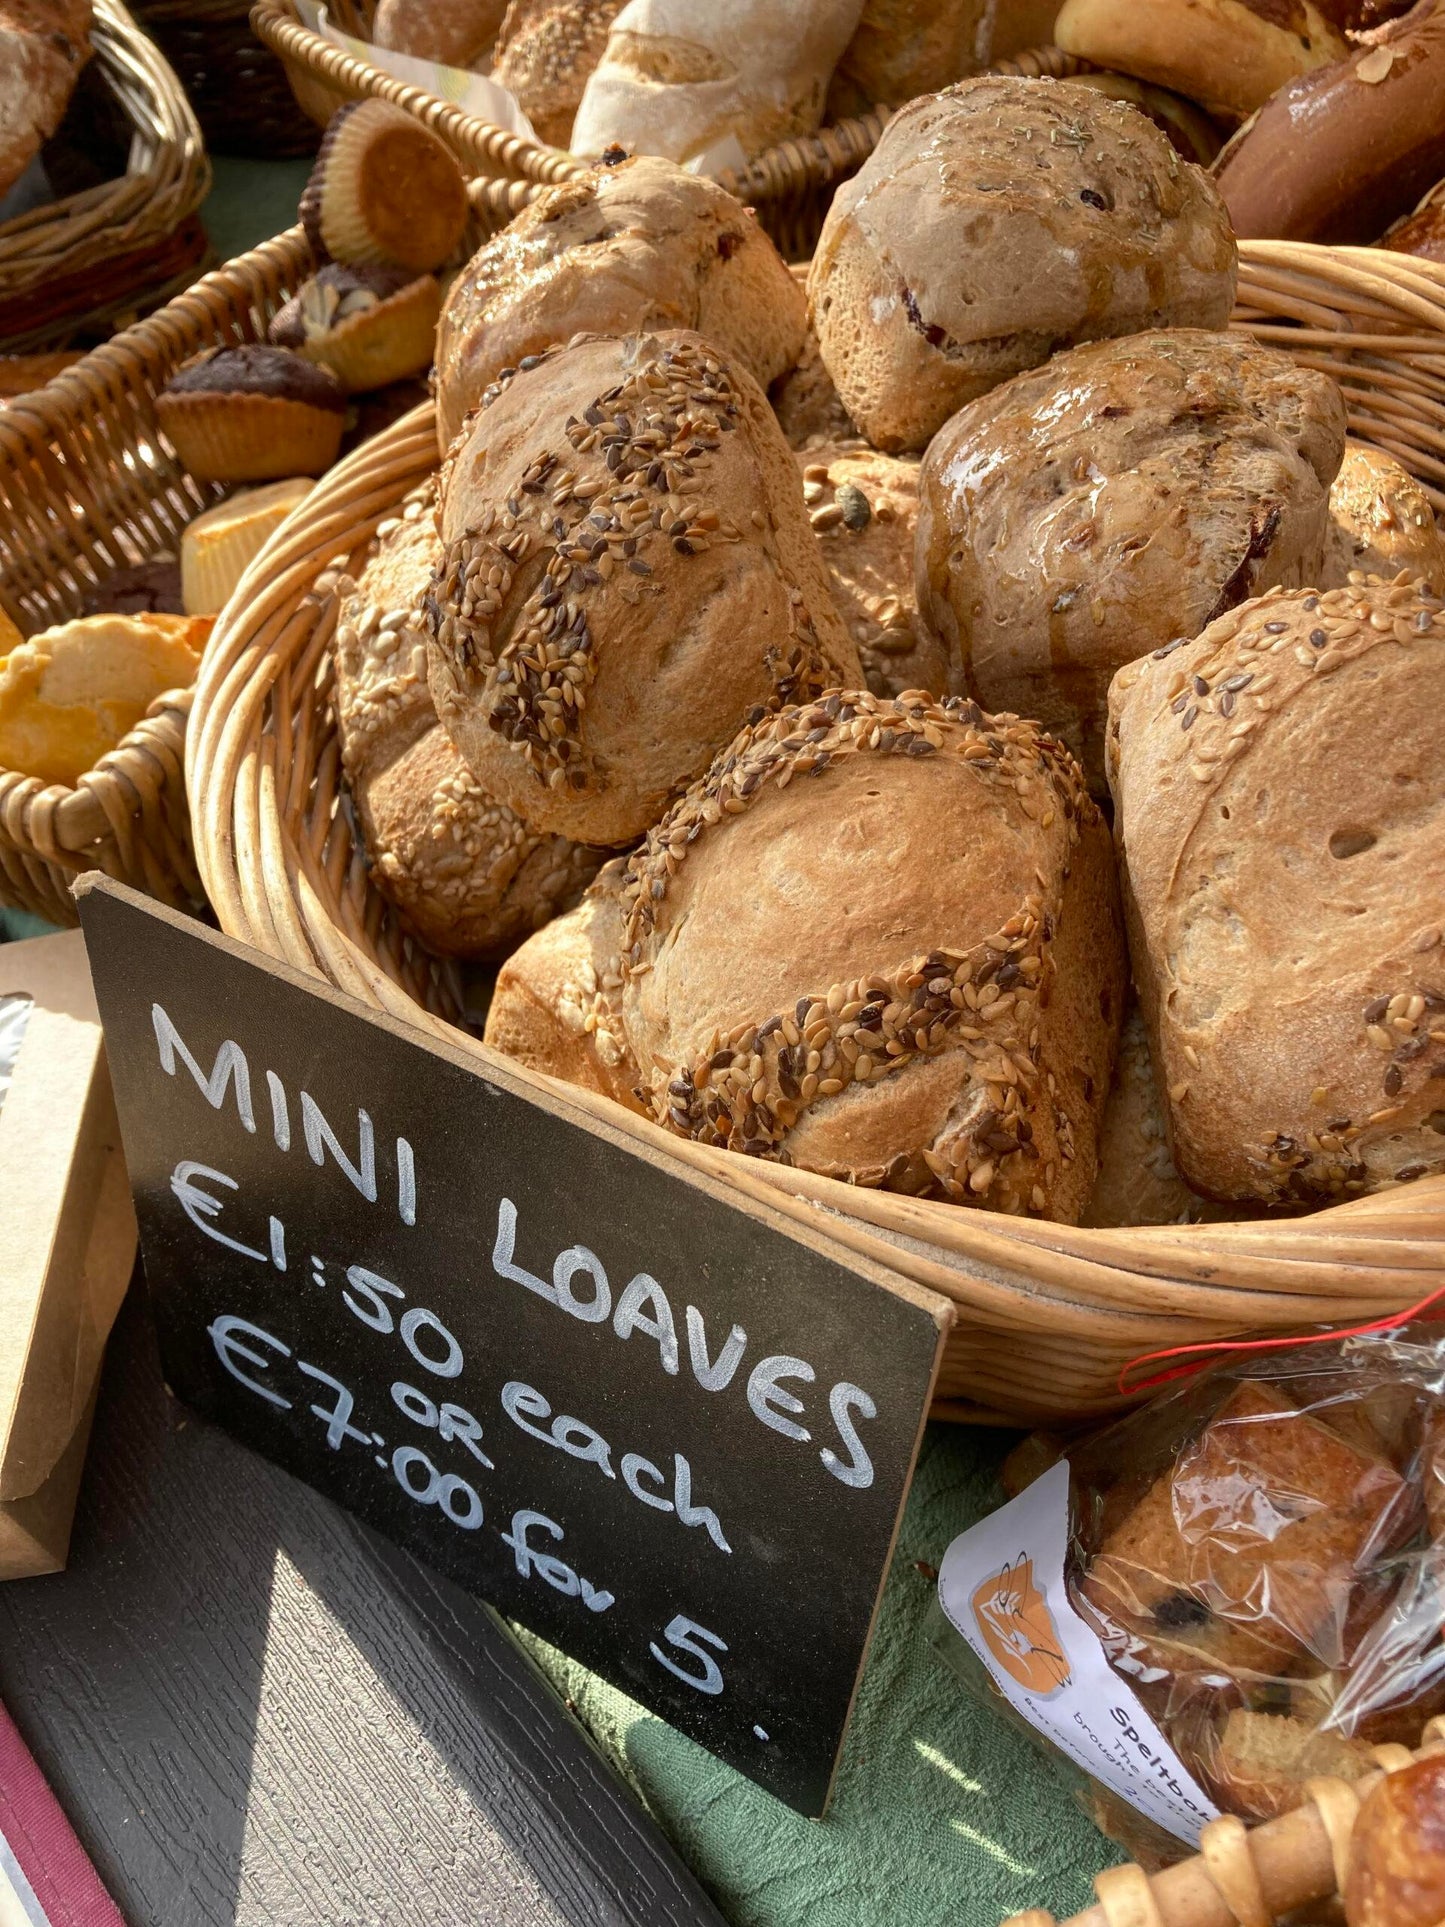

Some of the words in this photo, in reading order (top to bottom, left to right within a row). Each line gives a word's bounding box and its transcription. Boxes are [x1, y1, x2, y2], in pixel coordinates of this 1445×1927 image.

[151, 1002, 417, 1226] MINI
[492, 1197, 878, 1489] LOAVES
[390, 1381, 495, 1470] OR
[500, 1381, 733, 1554] each
[501, 1509, 616, 1612] for
[1073, 1711, 1135, 1778] brought
[1113, 1736, 1141, 1774] The
